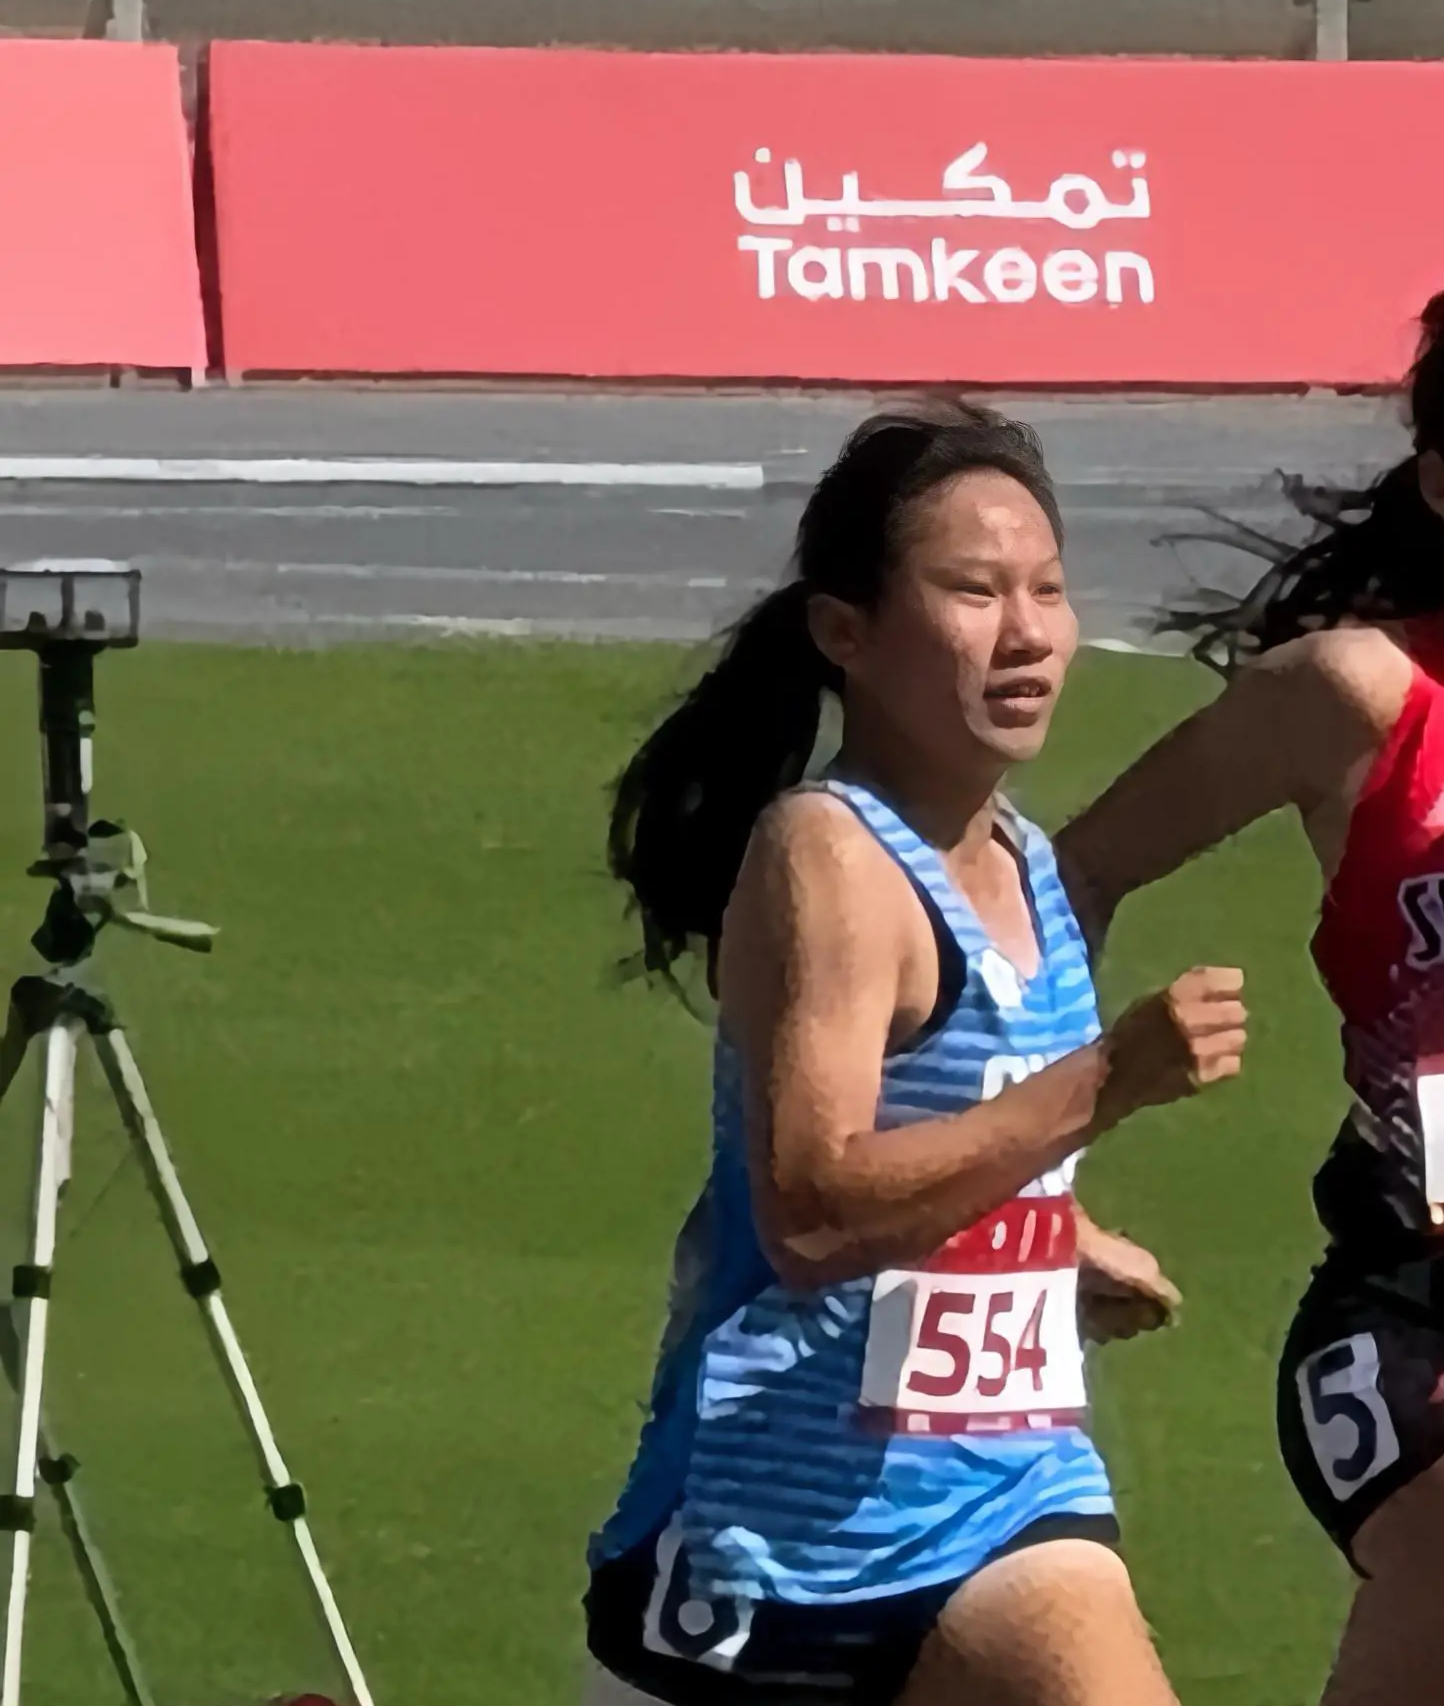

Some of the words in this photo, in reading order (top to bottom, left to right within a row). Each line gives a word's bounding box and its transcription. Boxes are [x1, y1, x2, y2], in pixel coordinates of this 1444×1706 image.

[733, 141, 1151, 232] تمكين
[737, 235, 1155, 304] Tamkeen
[906, 1289, 1049, 1397] 554
[1307, 1343, 1378, 1483] 5
